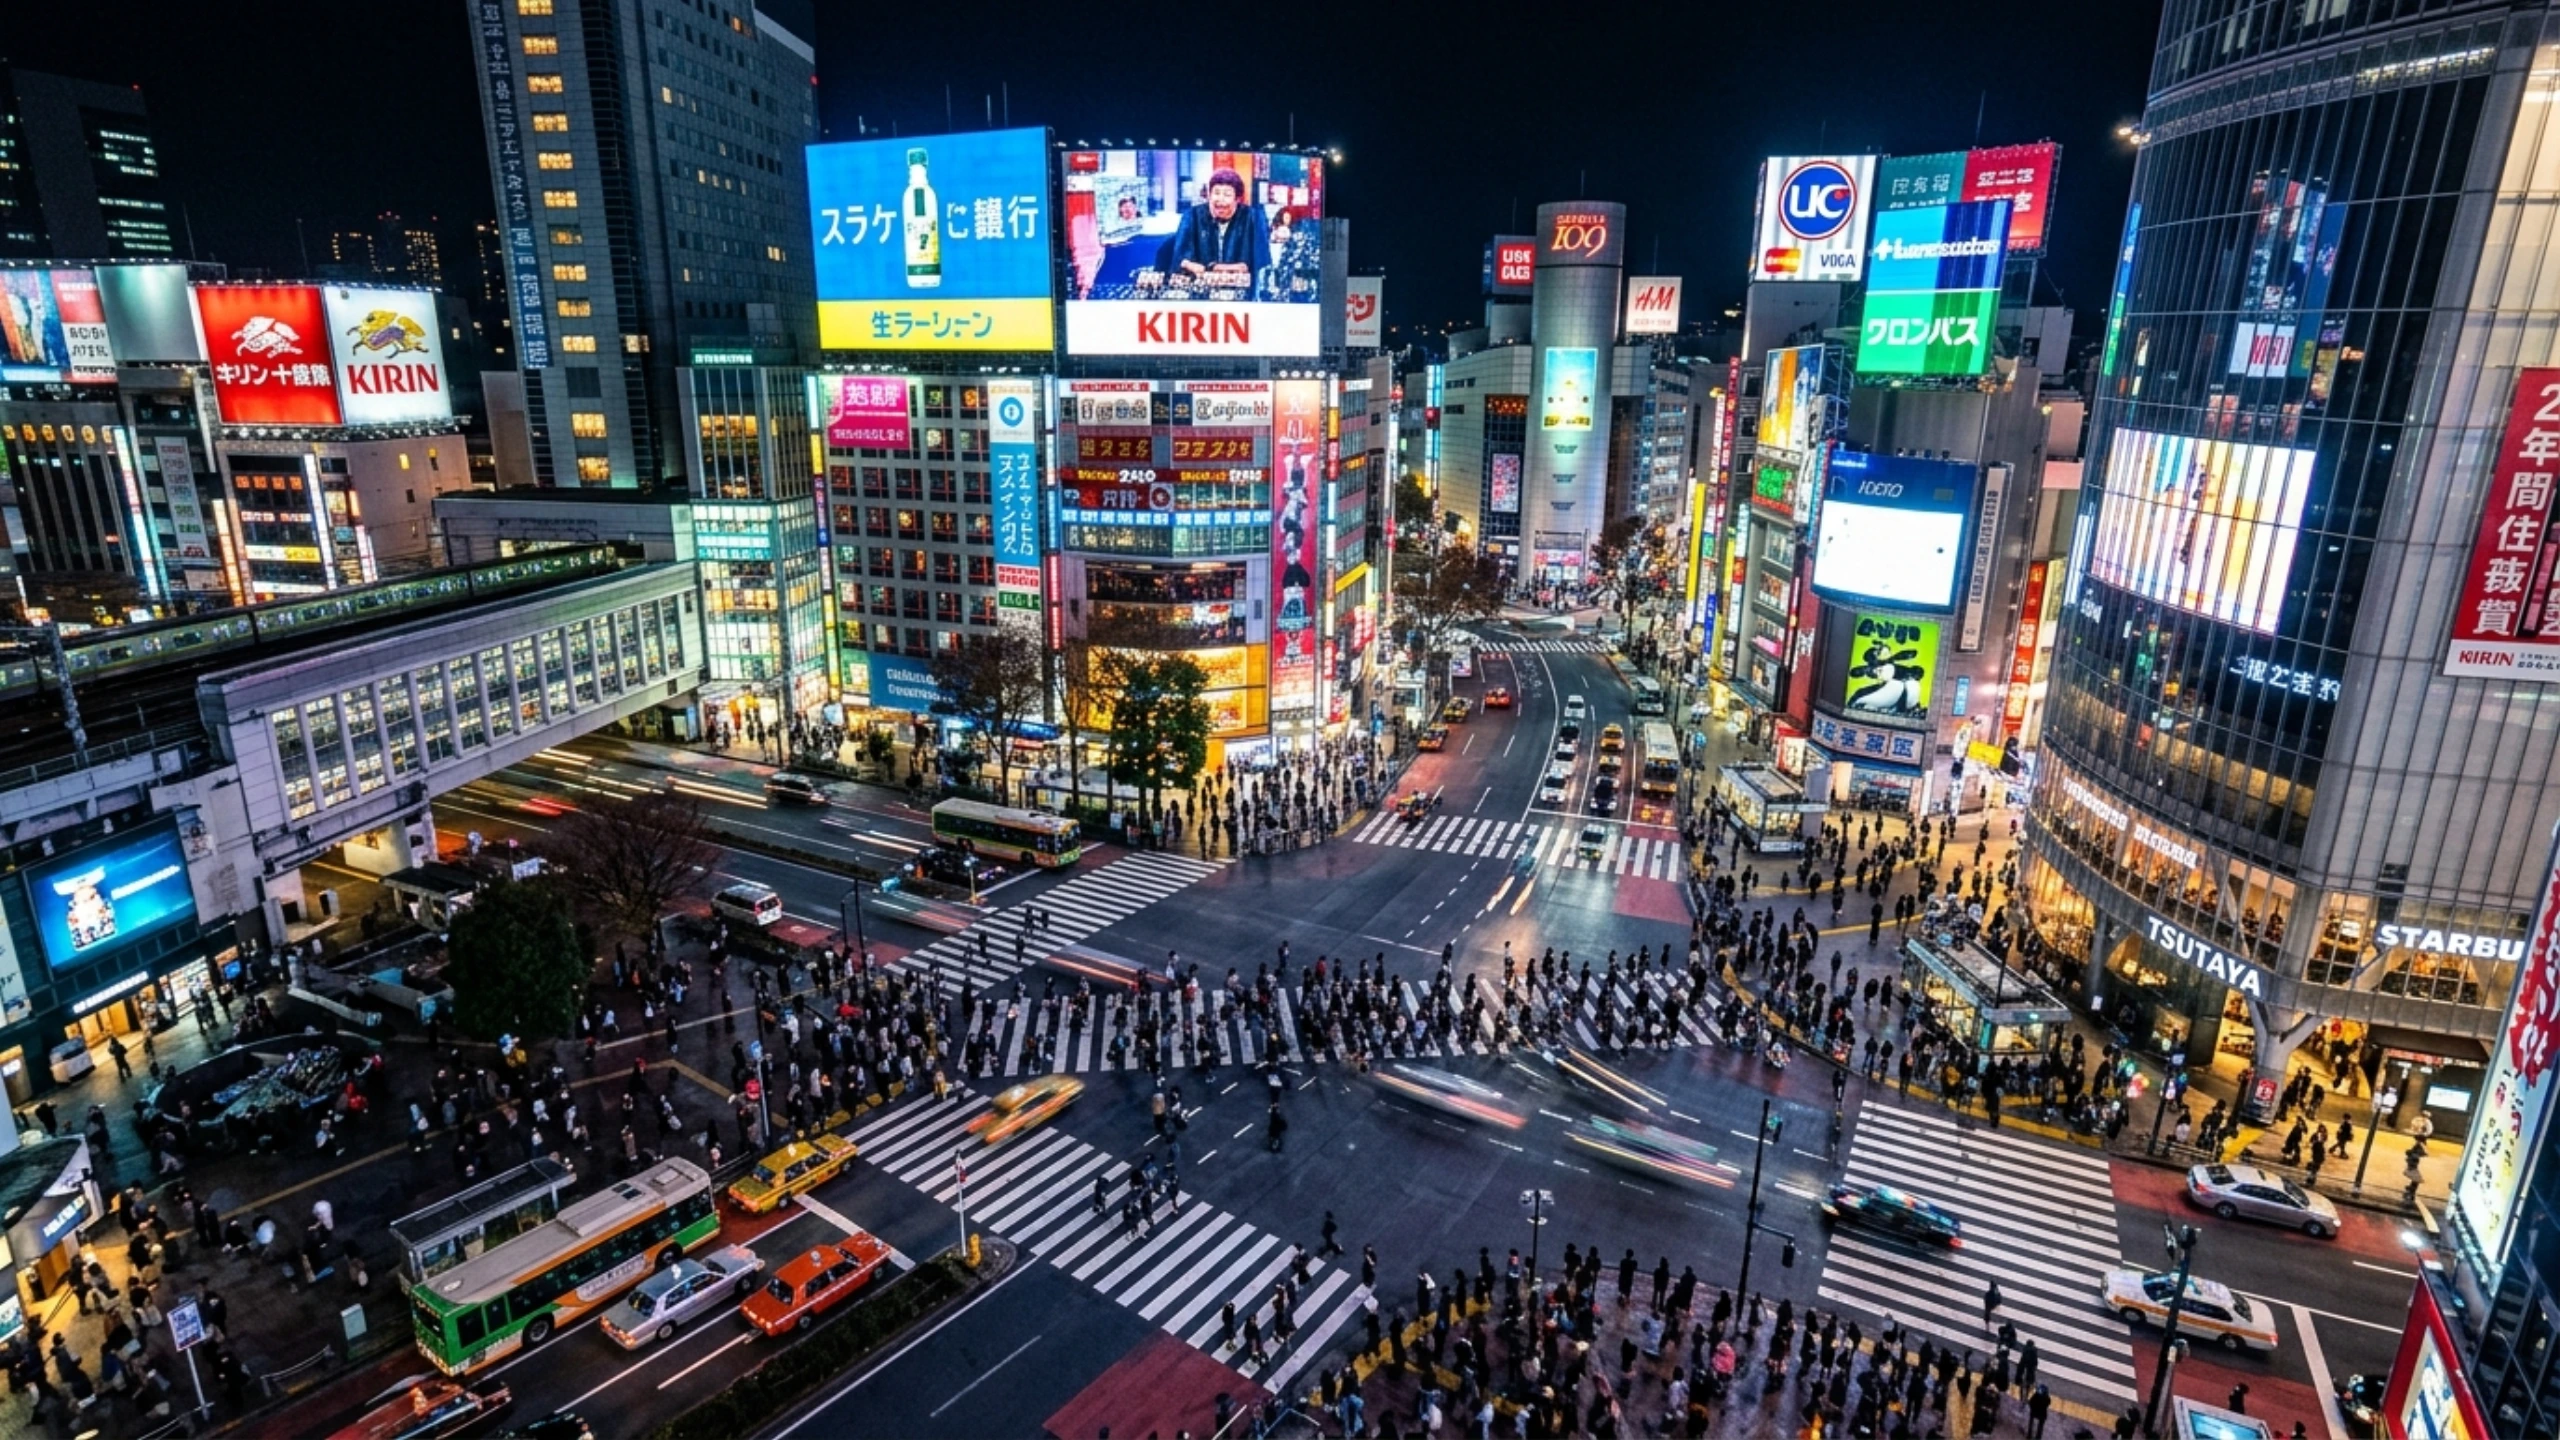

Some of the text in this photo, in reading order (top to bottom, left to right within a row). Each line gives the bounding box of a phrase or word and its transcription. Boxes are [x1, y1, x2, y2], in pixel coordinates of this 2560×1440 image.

[1790, 184, 1851, 219] UC
[1551, 224, 1607, 259] 109
[1137, 312, 1250, 344] KIRIN
[347, 363, 439, 394] KIRIN
[2458, 649, 2515, 667] KIRIN
[2148, 915, 2261, 998] TSUTAYA
[2377, 924, 2526, 961] STARBU
